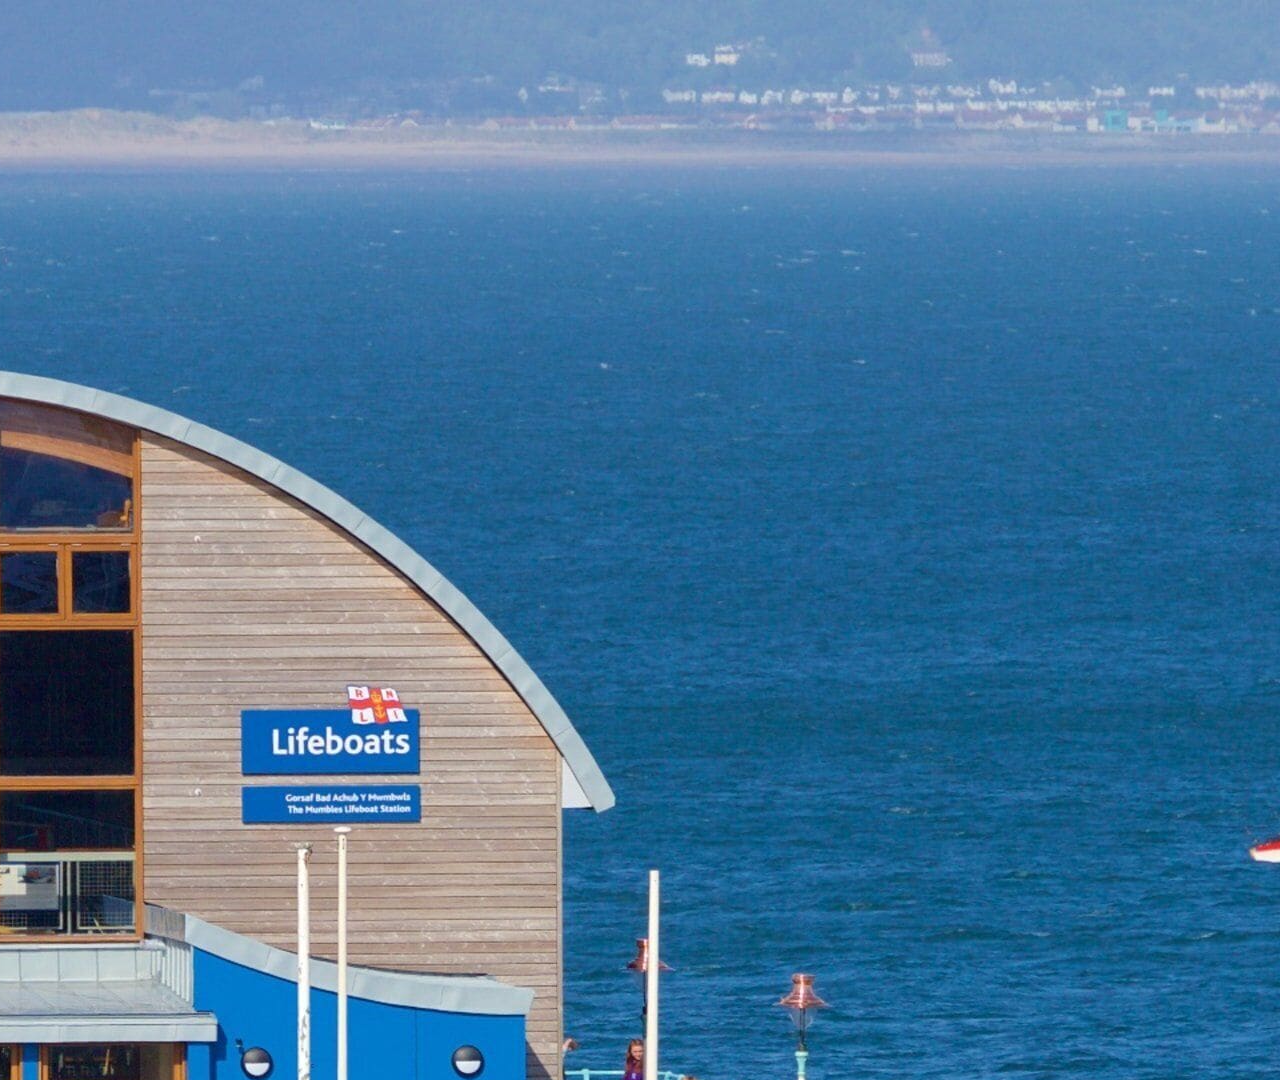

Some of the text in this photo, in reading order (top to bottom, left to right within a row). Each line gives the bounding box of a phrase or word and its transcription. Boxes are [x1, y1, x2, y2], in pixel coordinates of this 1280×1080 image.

[355, 688, 394, 698] R N
[360, 712, 367, 722] L
[272, 727, 410, 755] Lifeboats
[285, 793, 314, 803] Gorsaf
[315, 793, 331, 802] Bad
[332, 793, 359, 802] Achub
[360, 793, 366, 801] Y
[287, 804, 411, 814] The Mumbles Lifeboat Station
